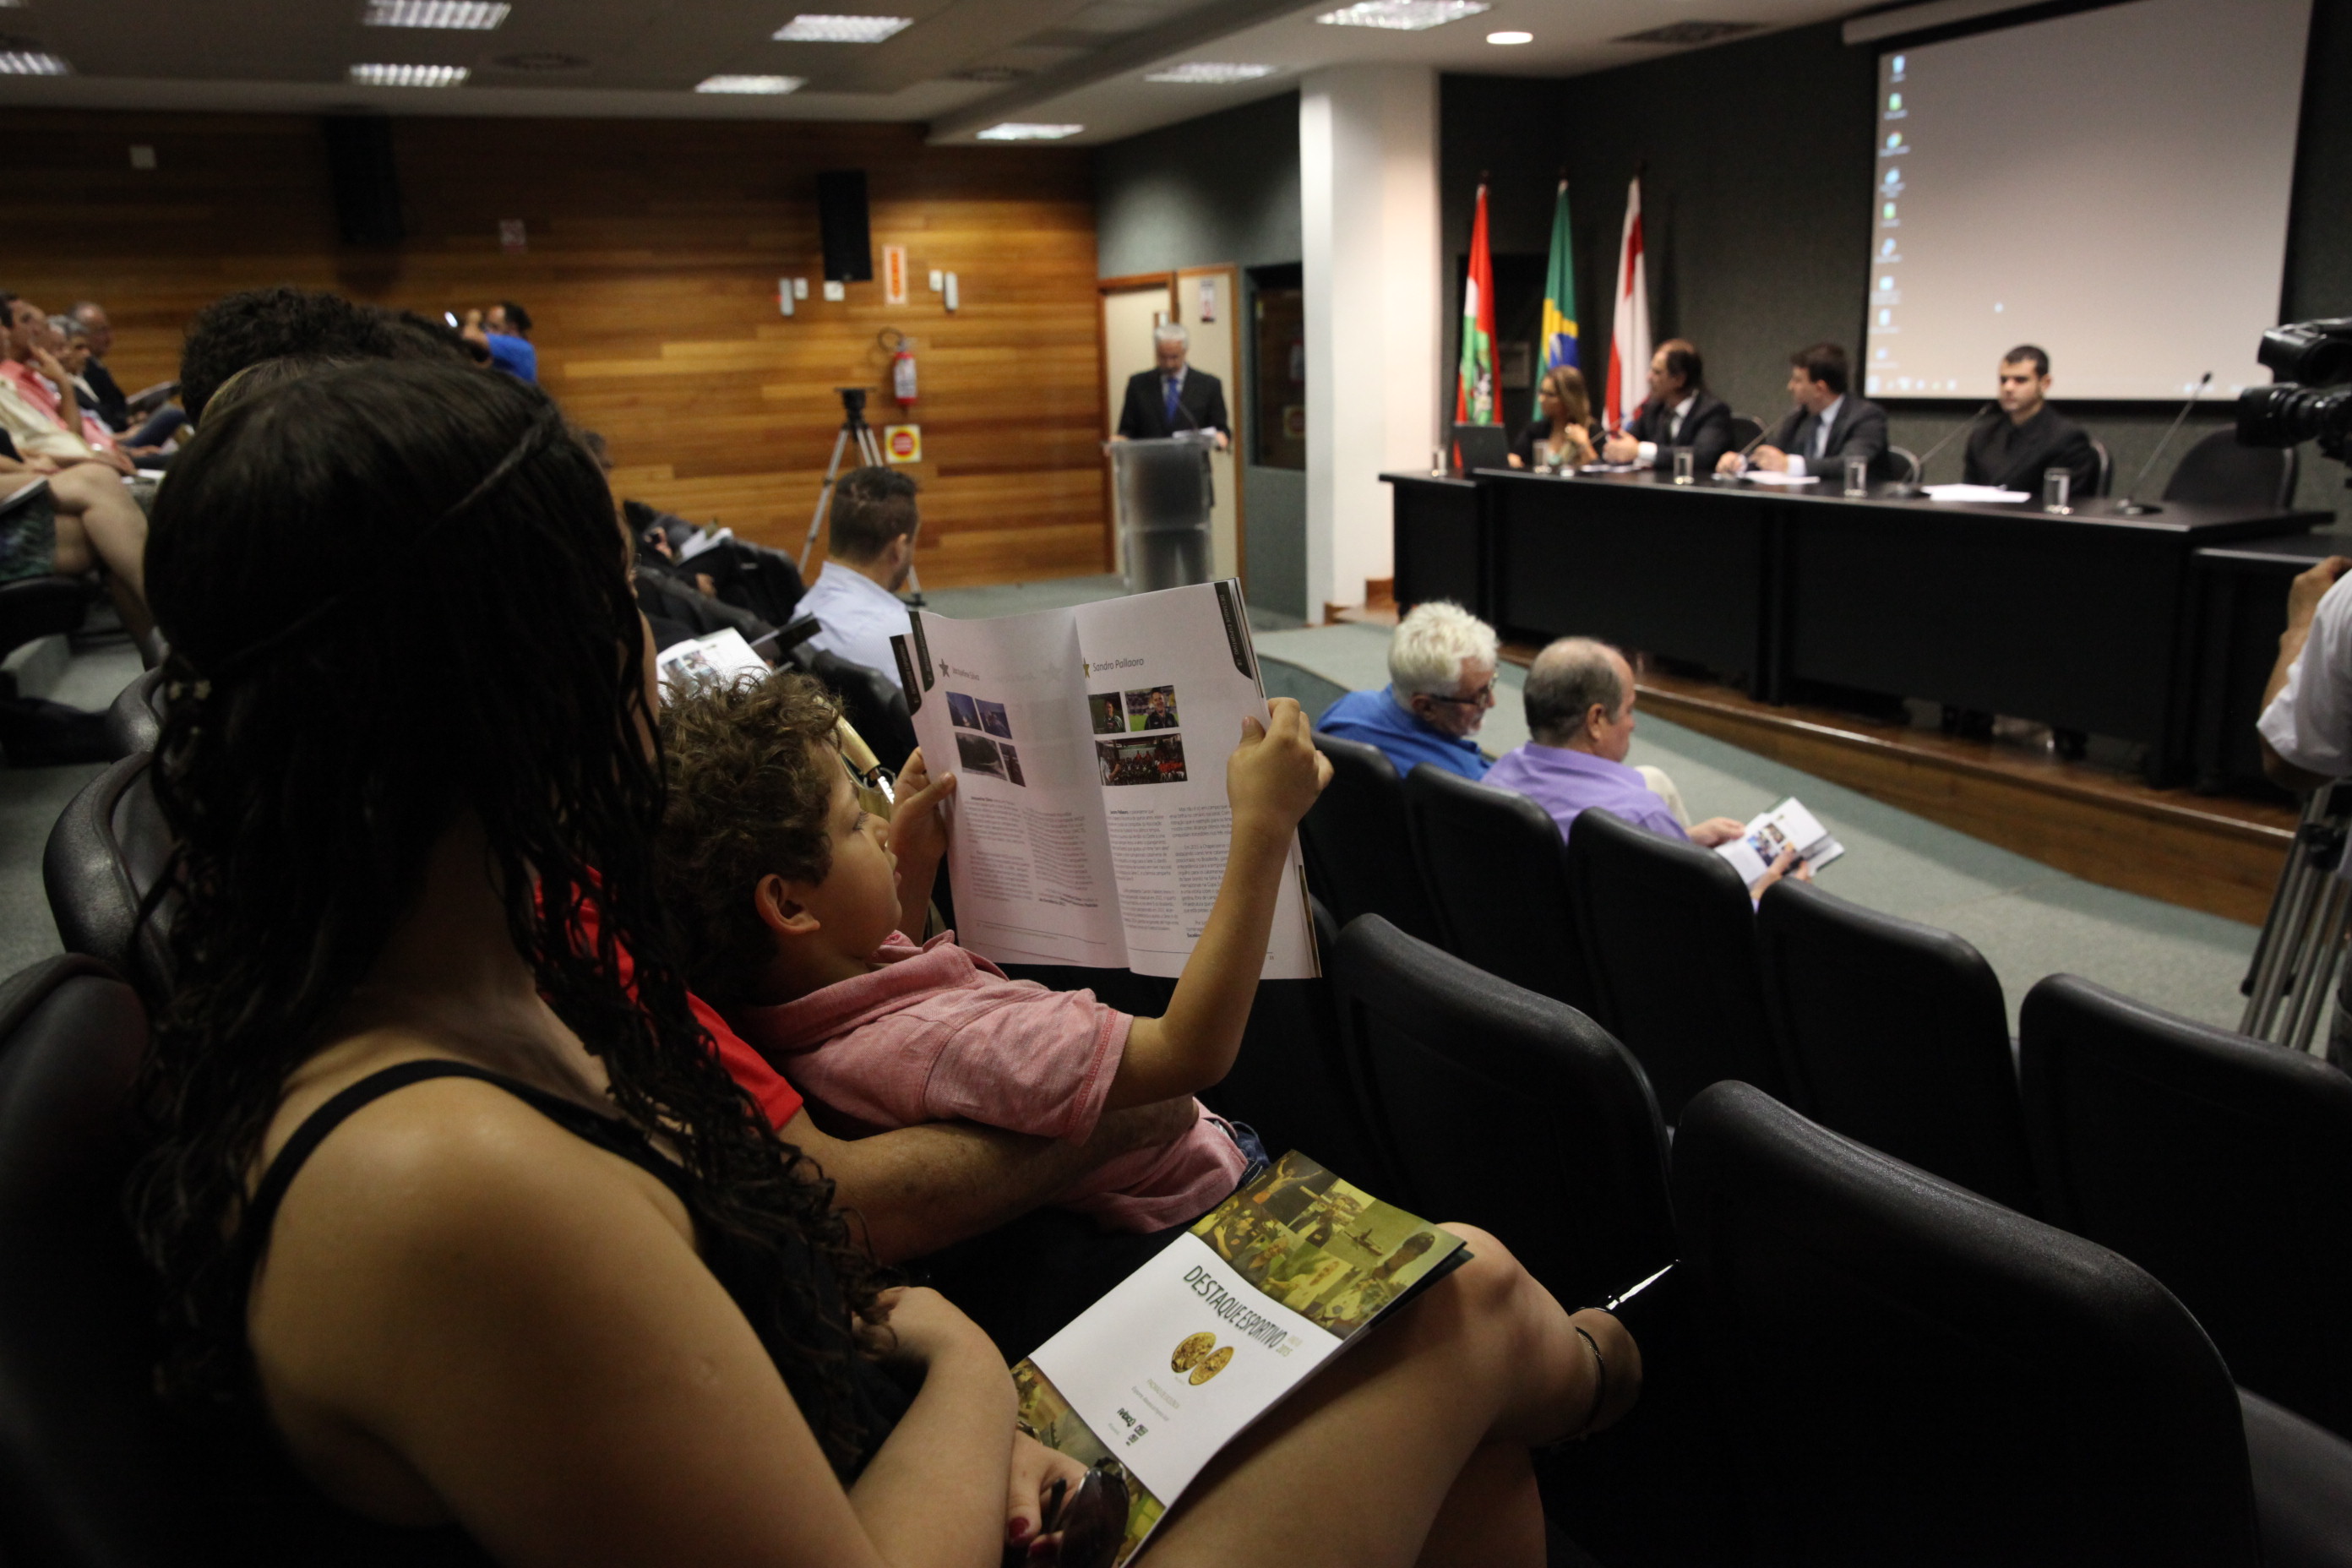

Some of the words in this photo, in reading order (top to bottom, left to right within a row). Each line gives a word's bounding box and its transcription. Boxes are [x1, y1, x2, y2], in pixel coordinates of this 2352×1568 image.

[1219, 594, 1231, 623] DESTAQUE
[1227, 623, 1240, 656] ESPORTIVO
[1092, 660, 1114, 672] Sandro
[1115, 657, 1145, 669] Pallaoro
[1183, 1265, 1248, 1324] DESTAQUE
[1234, 1309, 1288, 1349] ESPORTIVO
